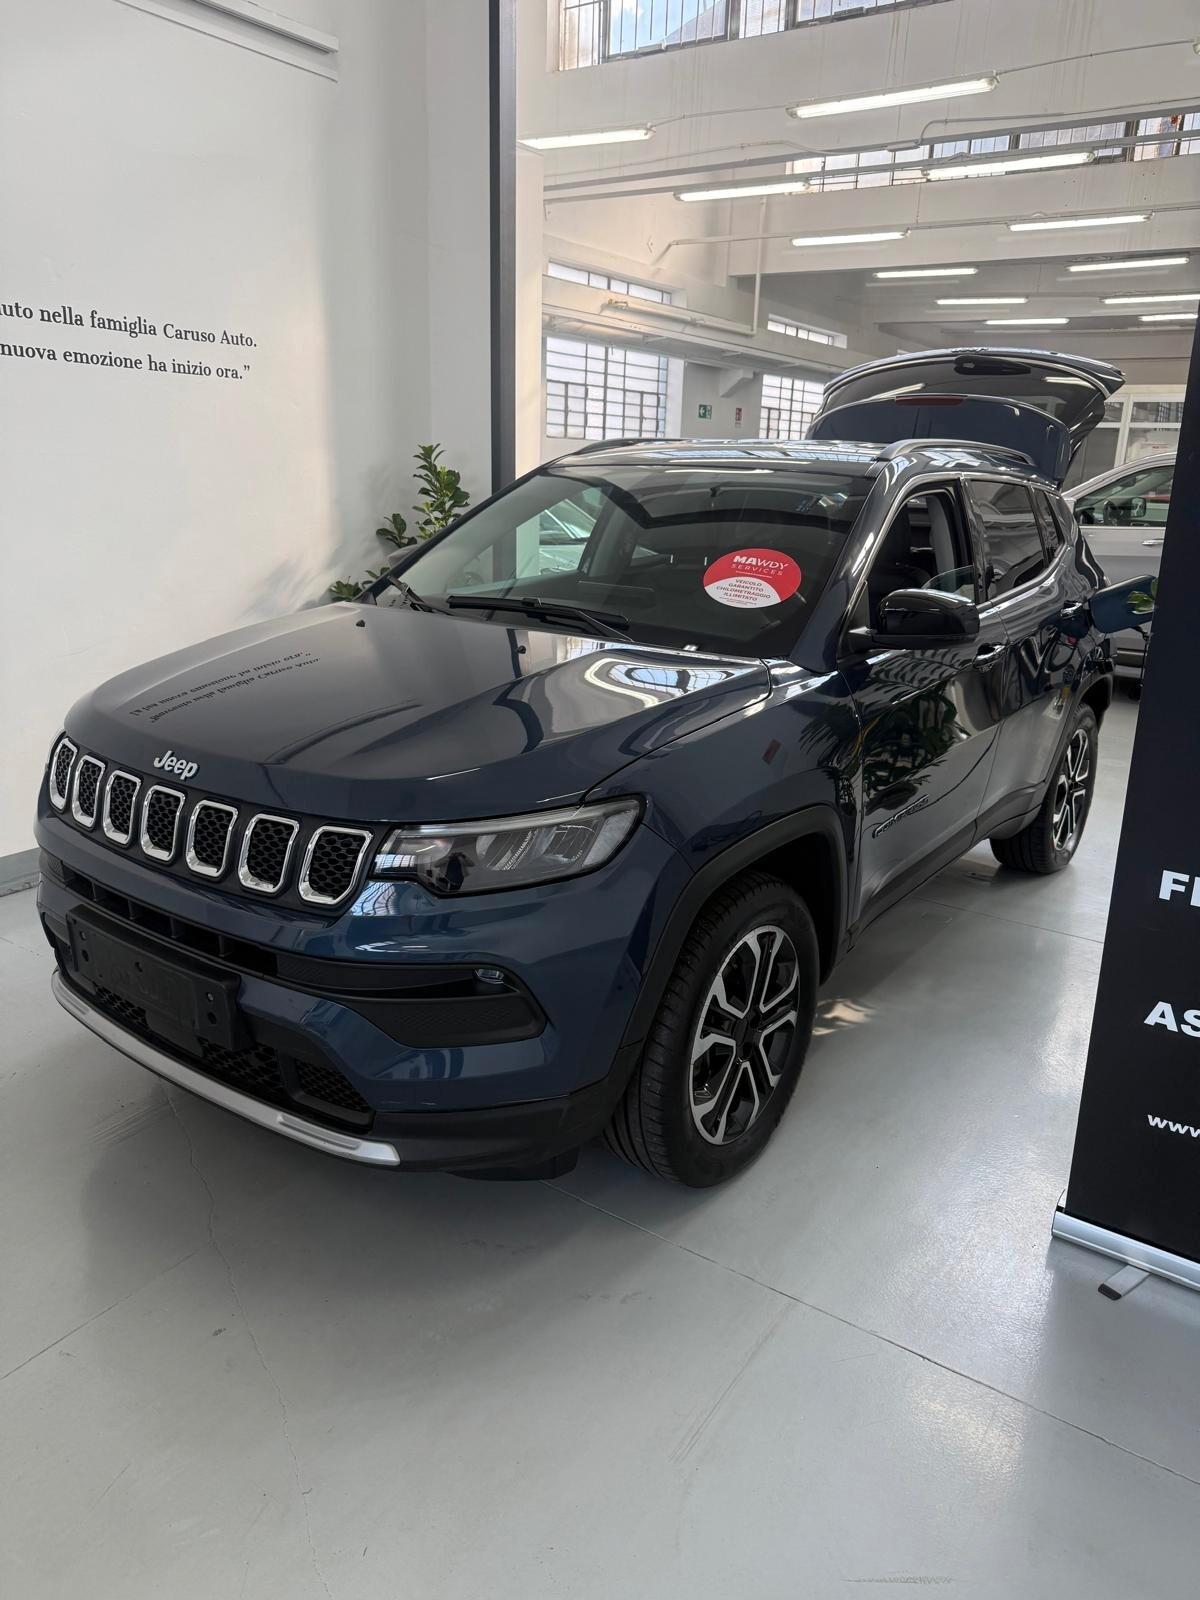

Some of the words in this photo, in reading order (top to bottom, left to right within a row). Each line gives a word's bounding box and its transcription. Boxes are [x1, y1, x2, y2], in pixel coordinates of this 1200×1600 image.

[0, 302, 33, 319] uto
[39, 305, 84, 326] nella
[90, 310, 157, 338] famiglia
[163, 323, 216, 343] Caruso
[220, 330, 257, 347] Auto.
[0, 343, 57, 361] nuova
[63, 351, 143, 370] emozione
[147, 354, 167, 372] ha
[172, 359, 211, 376] inizio
[731, 563, 783, 576] SERVICES
[733, 556, 788, 570] MAWDY
[728, 583, 764, 592] GARANTITO
[735, 579, 762, 587] VEICOLO
[716, 586, 771, 599] CHILOMETRAGGIO
[723, 592, 758, 602] ILLIMITATO
[153, 750, 199, 780] Jeep
